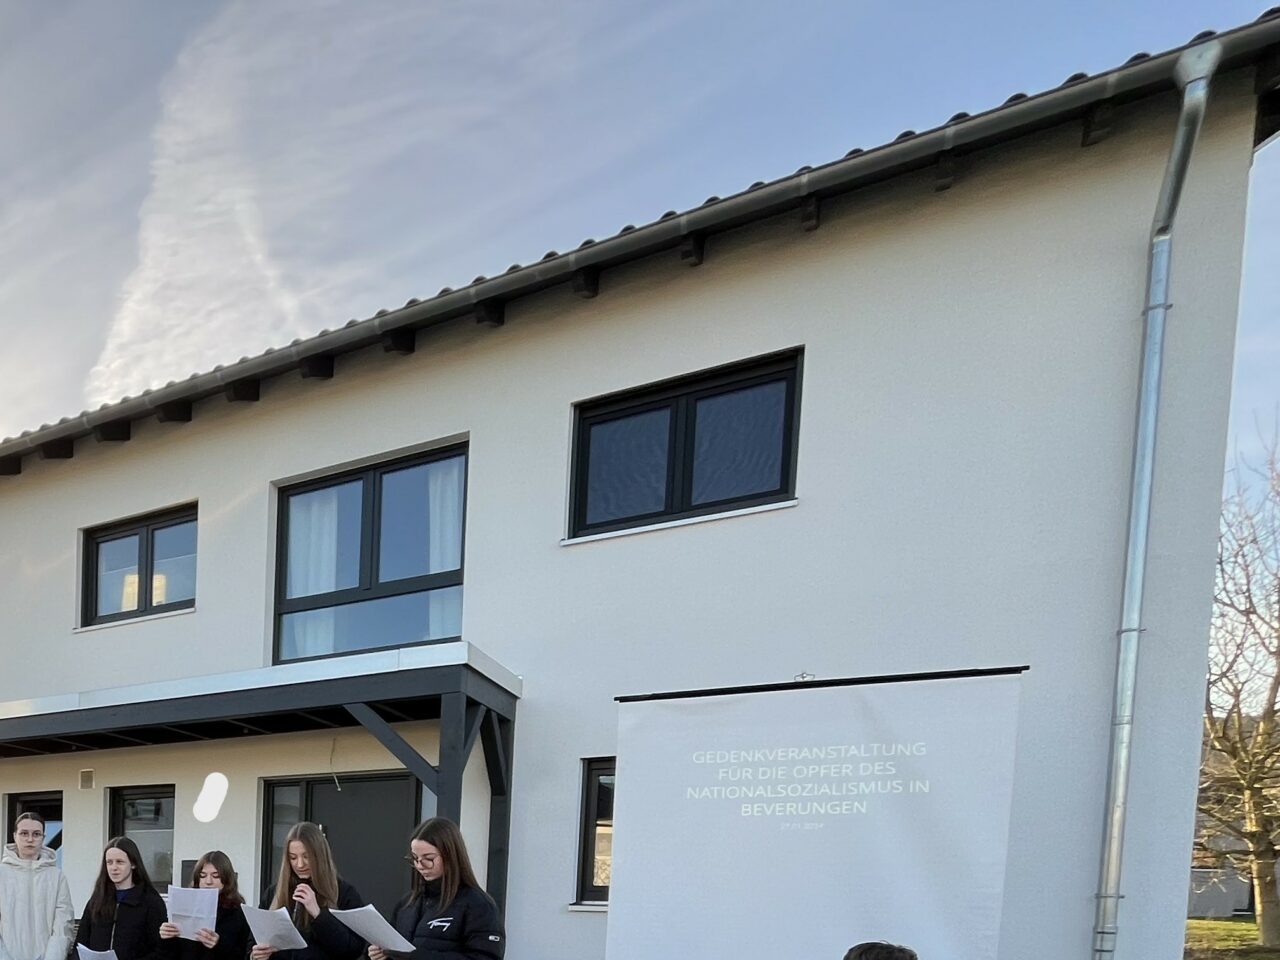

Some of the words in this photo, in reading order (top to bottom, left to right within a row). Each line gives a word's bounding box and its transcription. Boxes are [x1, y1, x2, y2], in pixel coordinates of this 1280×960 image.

[692, 741, 928, 764] GEDENKVERANSTALTUNG
[718, 765, 753, 781] FÜR
[758, 766, 788, 780] DIE
[793, 763, 853, 778] OPFER
[859, 761, 896, 776] DES
[686, 779, 904, 799] NATIONALSOZIALISMUS
[909, 779, 930, 793] IN
[741, 800, 867, 816] BEVERUNGEN
